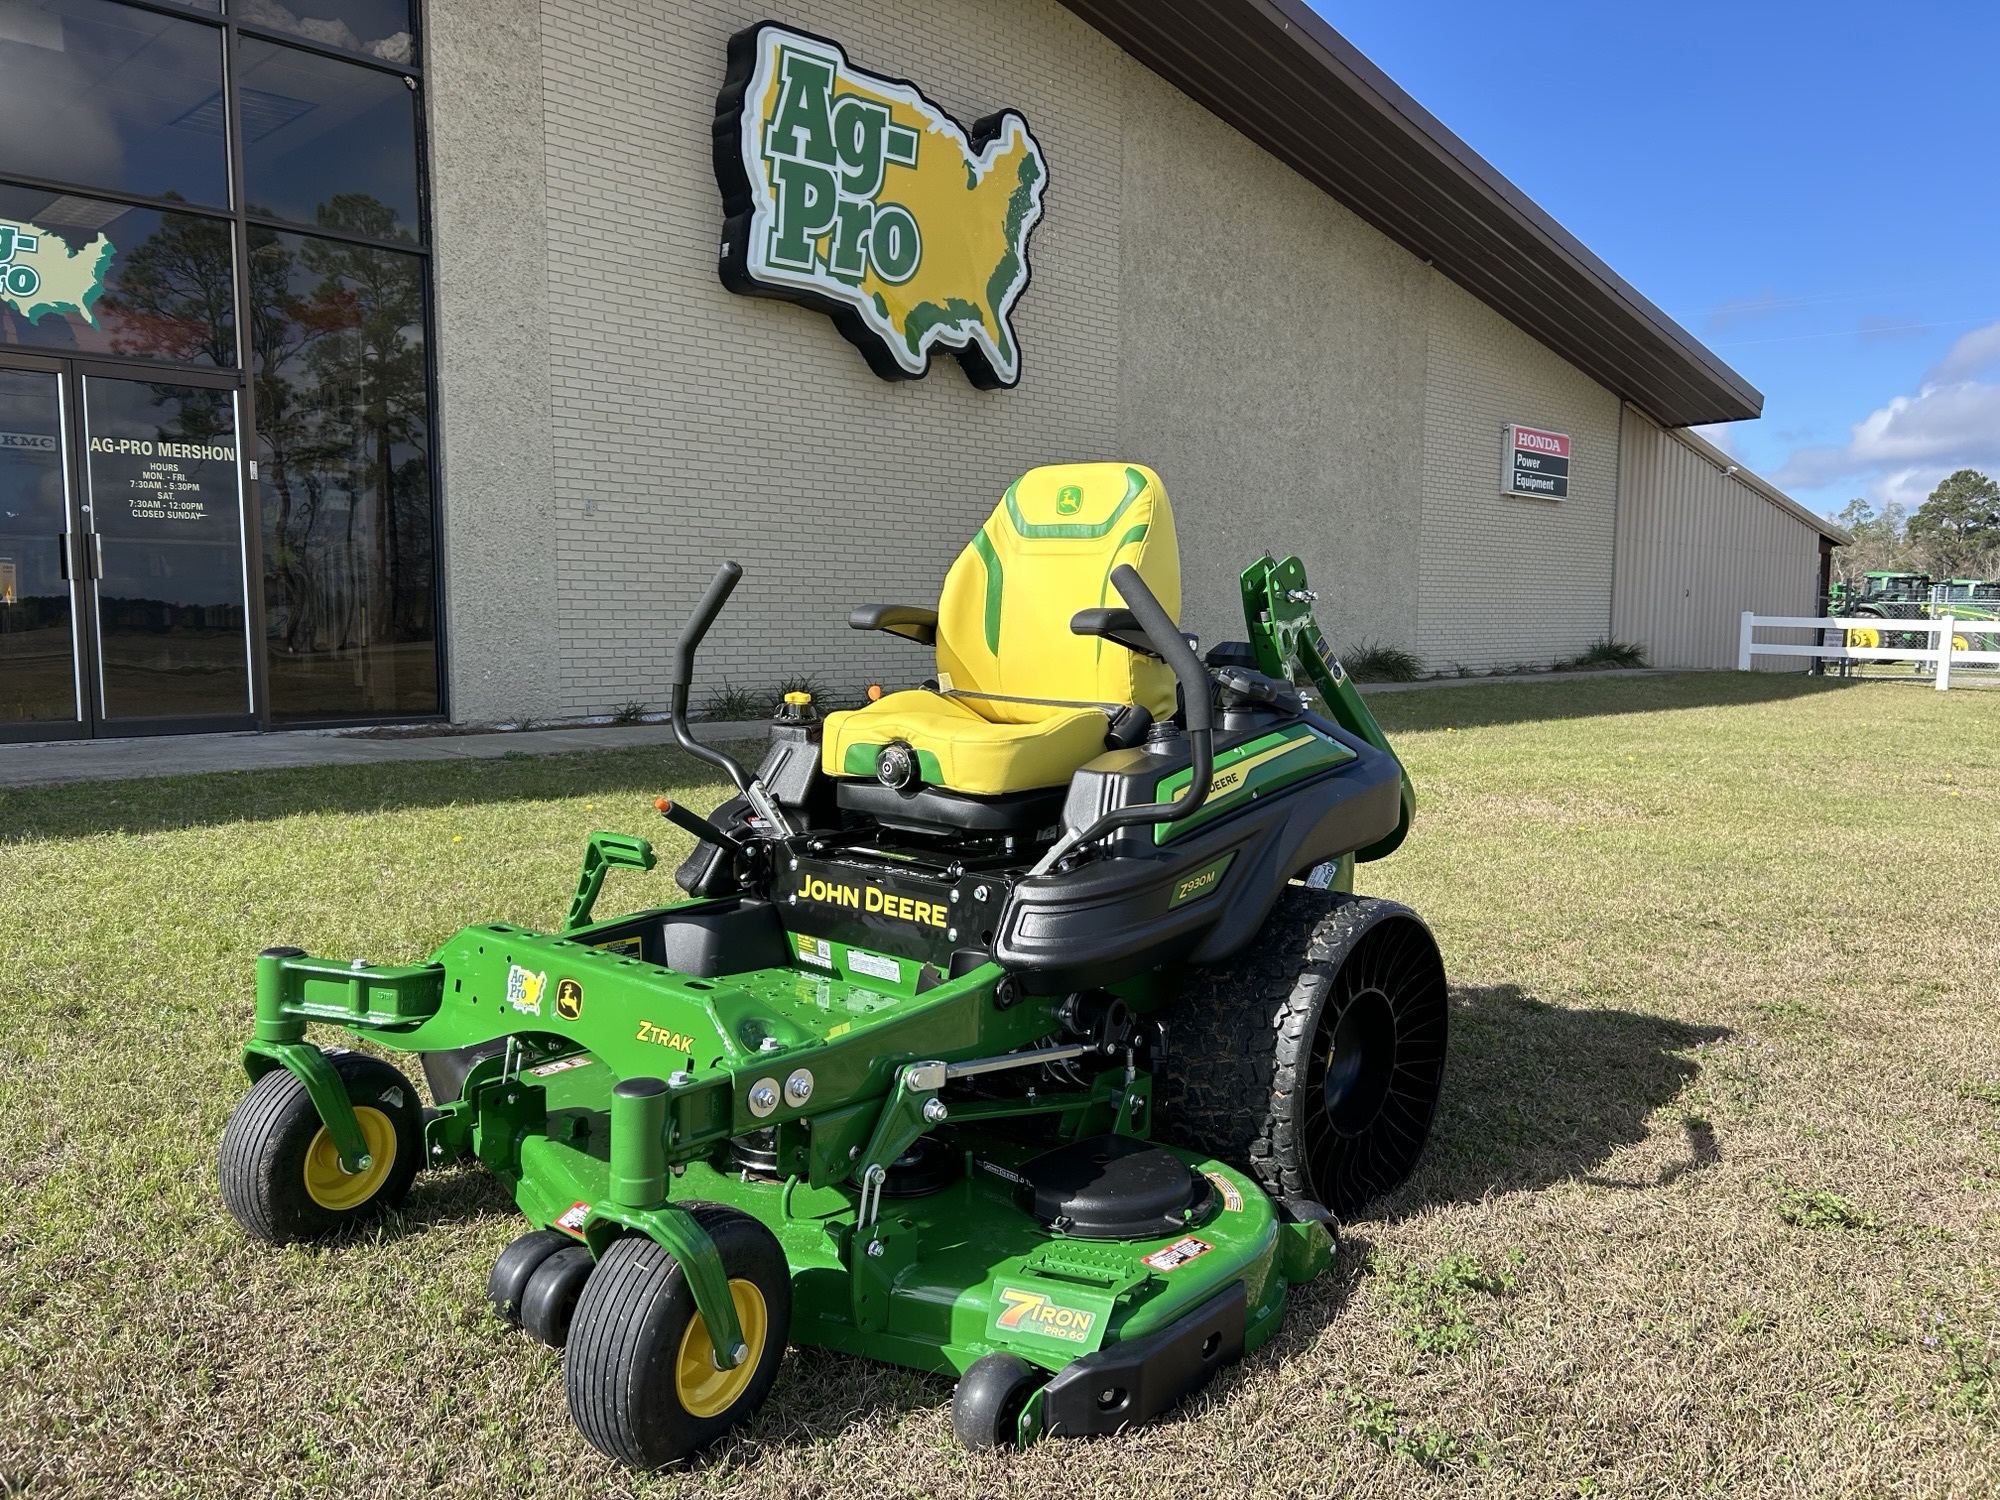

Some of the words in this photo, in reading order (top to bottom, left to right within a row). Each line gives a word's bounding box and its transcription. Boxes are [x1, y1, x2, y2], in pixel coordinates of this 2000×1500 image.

[763, 47, 919, 199] Ag-
[768, 158, 922, 285] Pro
[2, 435, 53, 448] KMC
[90, 437, 153, 456] AG-PRO
[158, 442, 235, 461] MERSHON
[1518, 432, 1561, 452] HONDA
[150, 463, 179, 472] HOURS
[1517, 453, 1540, 469] Power
[142, 472, 165, 480] MON.
[172, 473, 187, 481] FRI.
[1516, 473, 1554, 490] Equipment
[130, 480, 162, 489] 7:30AM
[169, 482, 200, 491] 5:30PM
[157, 492, 175, 500] SAT.
[129, 500, 161, 508] 7:30AM
[169, 502, 204, 511] 12:00PM
[132, 510, 165, 519] CLOSED
[167, 511, 201, 520] SUNDAY
[1179, 871, 1215, 899] Z930M
[798, 874, 859, 909] JOHN
[865, 886, 948, 928] DEERE
[510, 984, 526, 999] Pro
[636, 1020, 695, 1055] ZTRAK
[1043, 1325, 1067, 1337] PRO
[1069, 1331, 1085, 1341] 60
